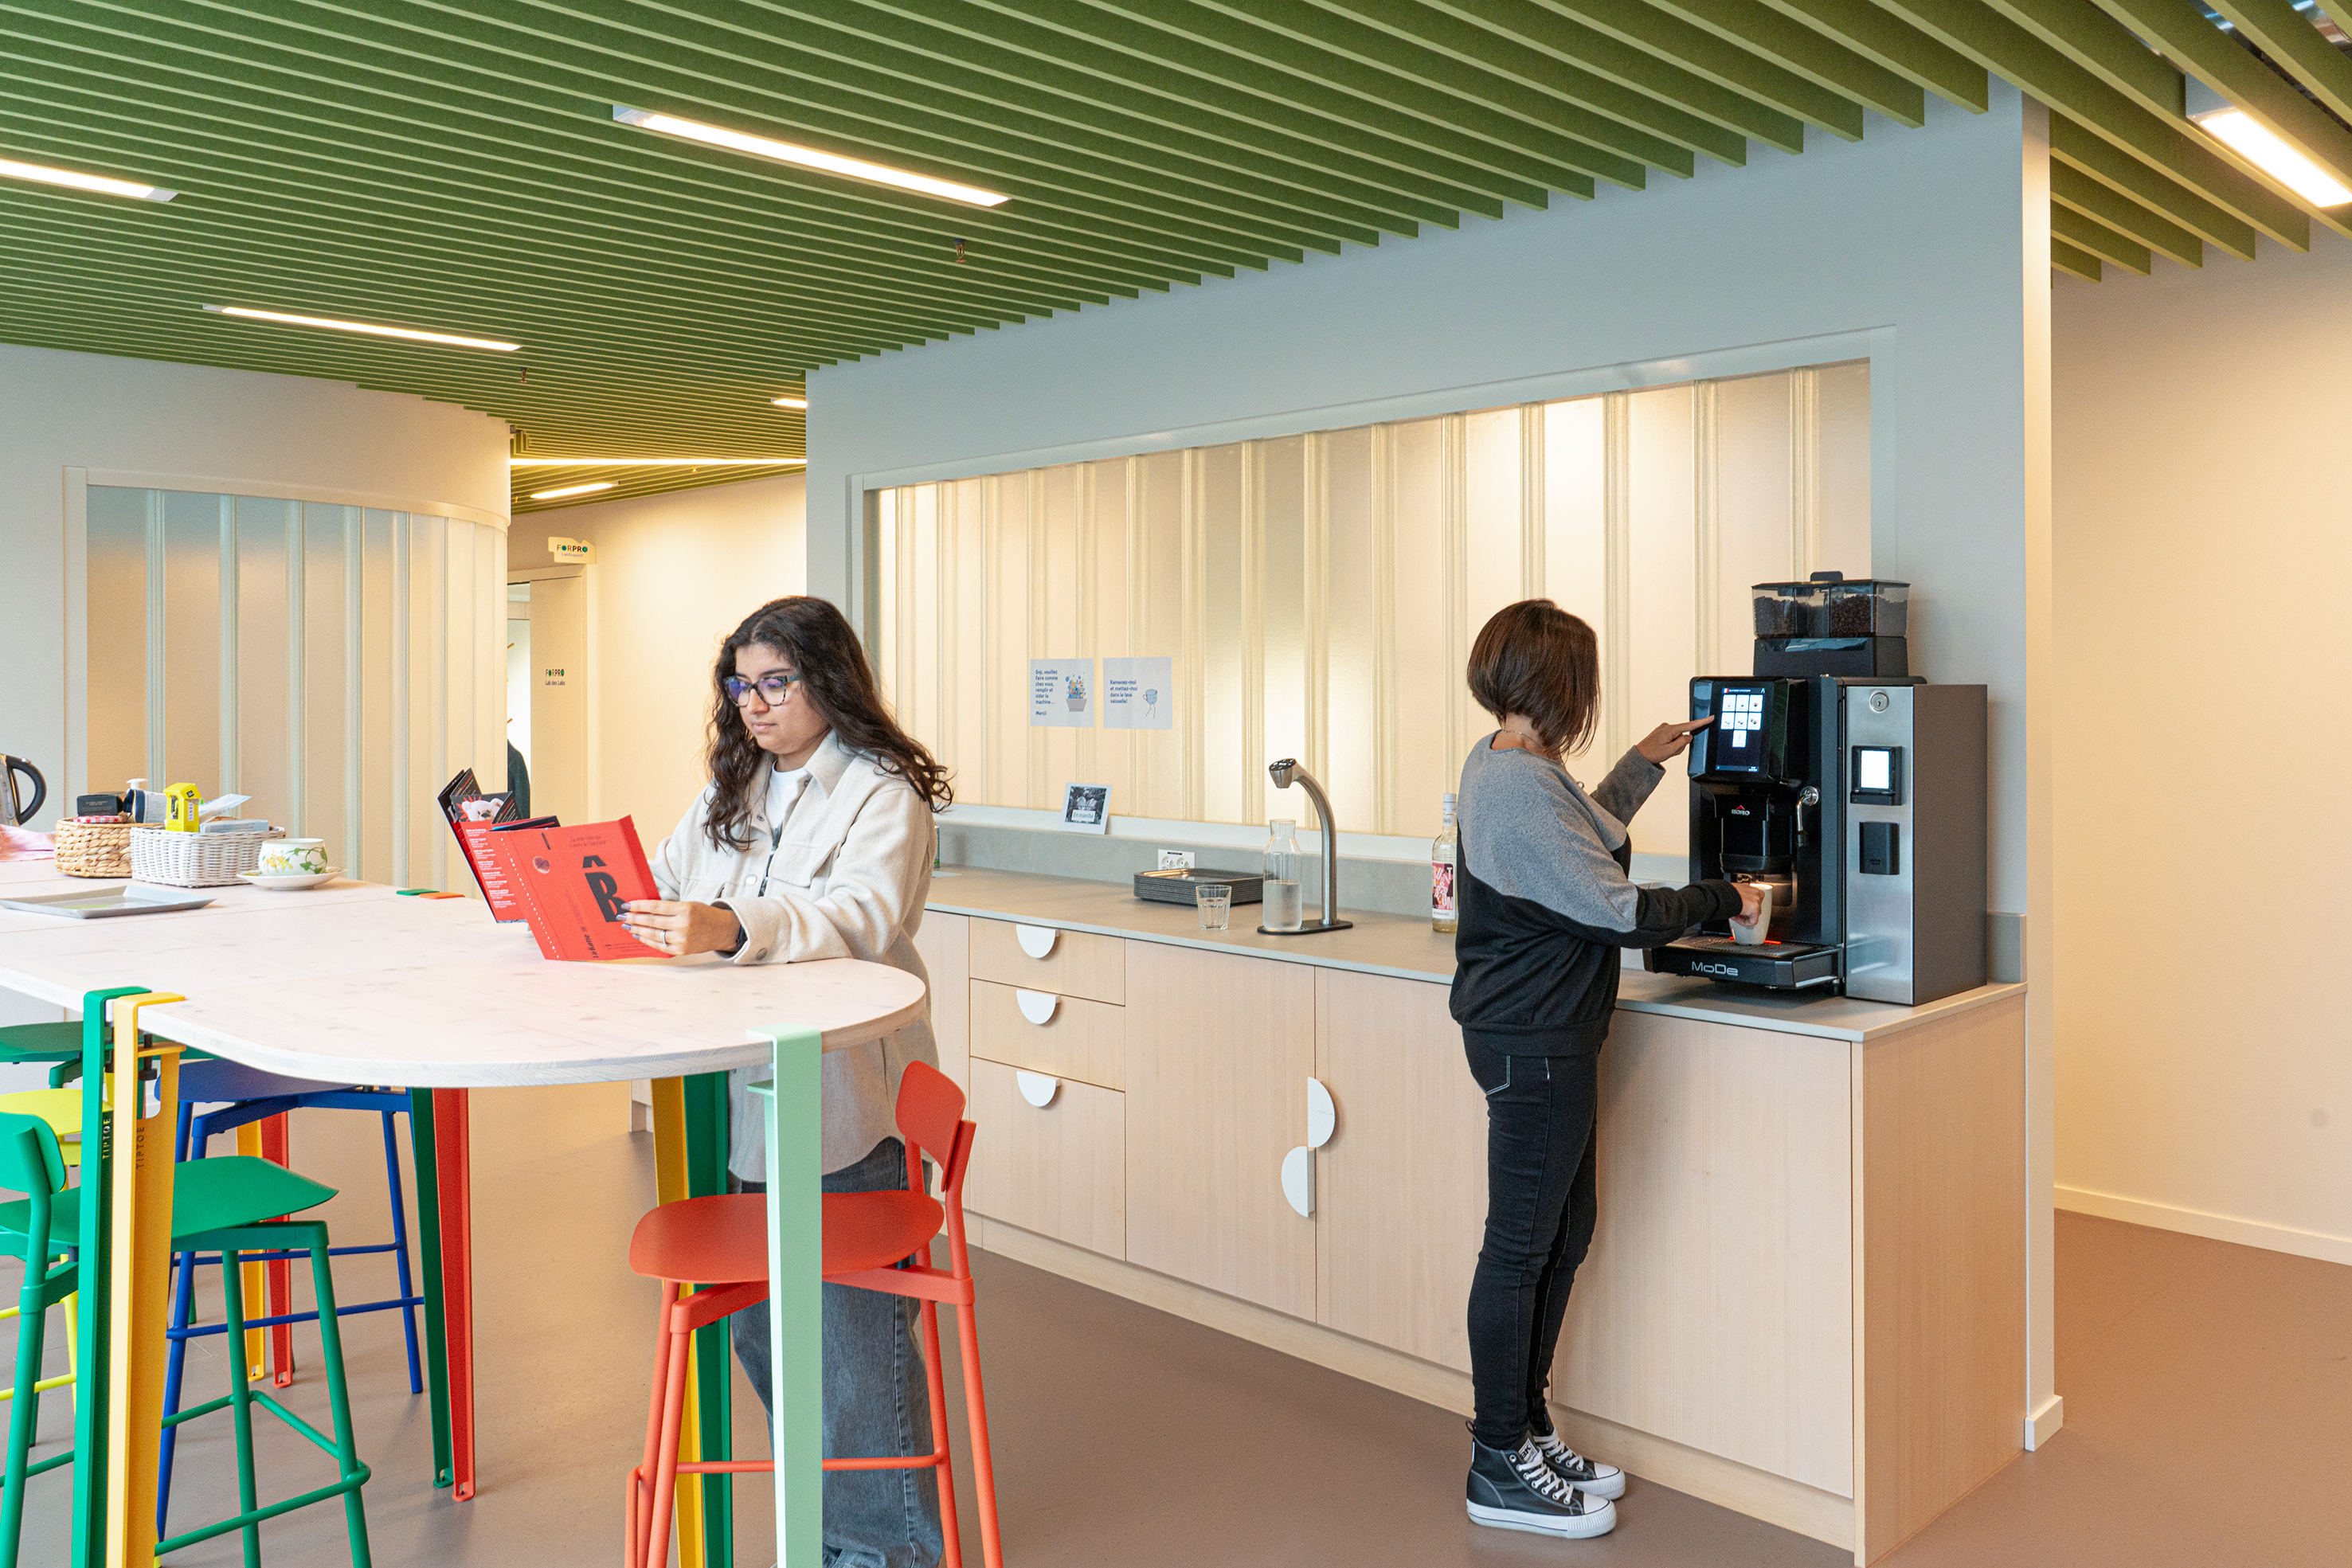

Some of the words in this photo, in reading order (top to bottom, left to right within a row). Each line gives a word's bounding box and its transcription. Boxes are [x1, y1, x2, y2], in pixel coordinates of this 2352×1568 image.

[556, 544, 589, 553] FORPRO
[545, 668, 565, 677] FORPRO
[1691, 960, 1739, 976] MoDe
[102, 1118, 112, 1159] TIPTOE
[135, 1126, 145, 1169] TIPTOE
